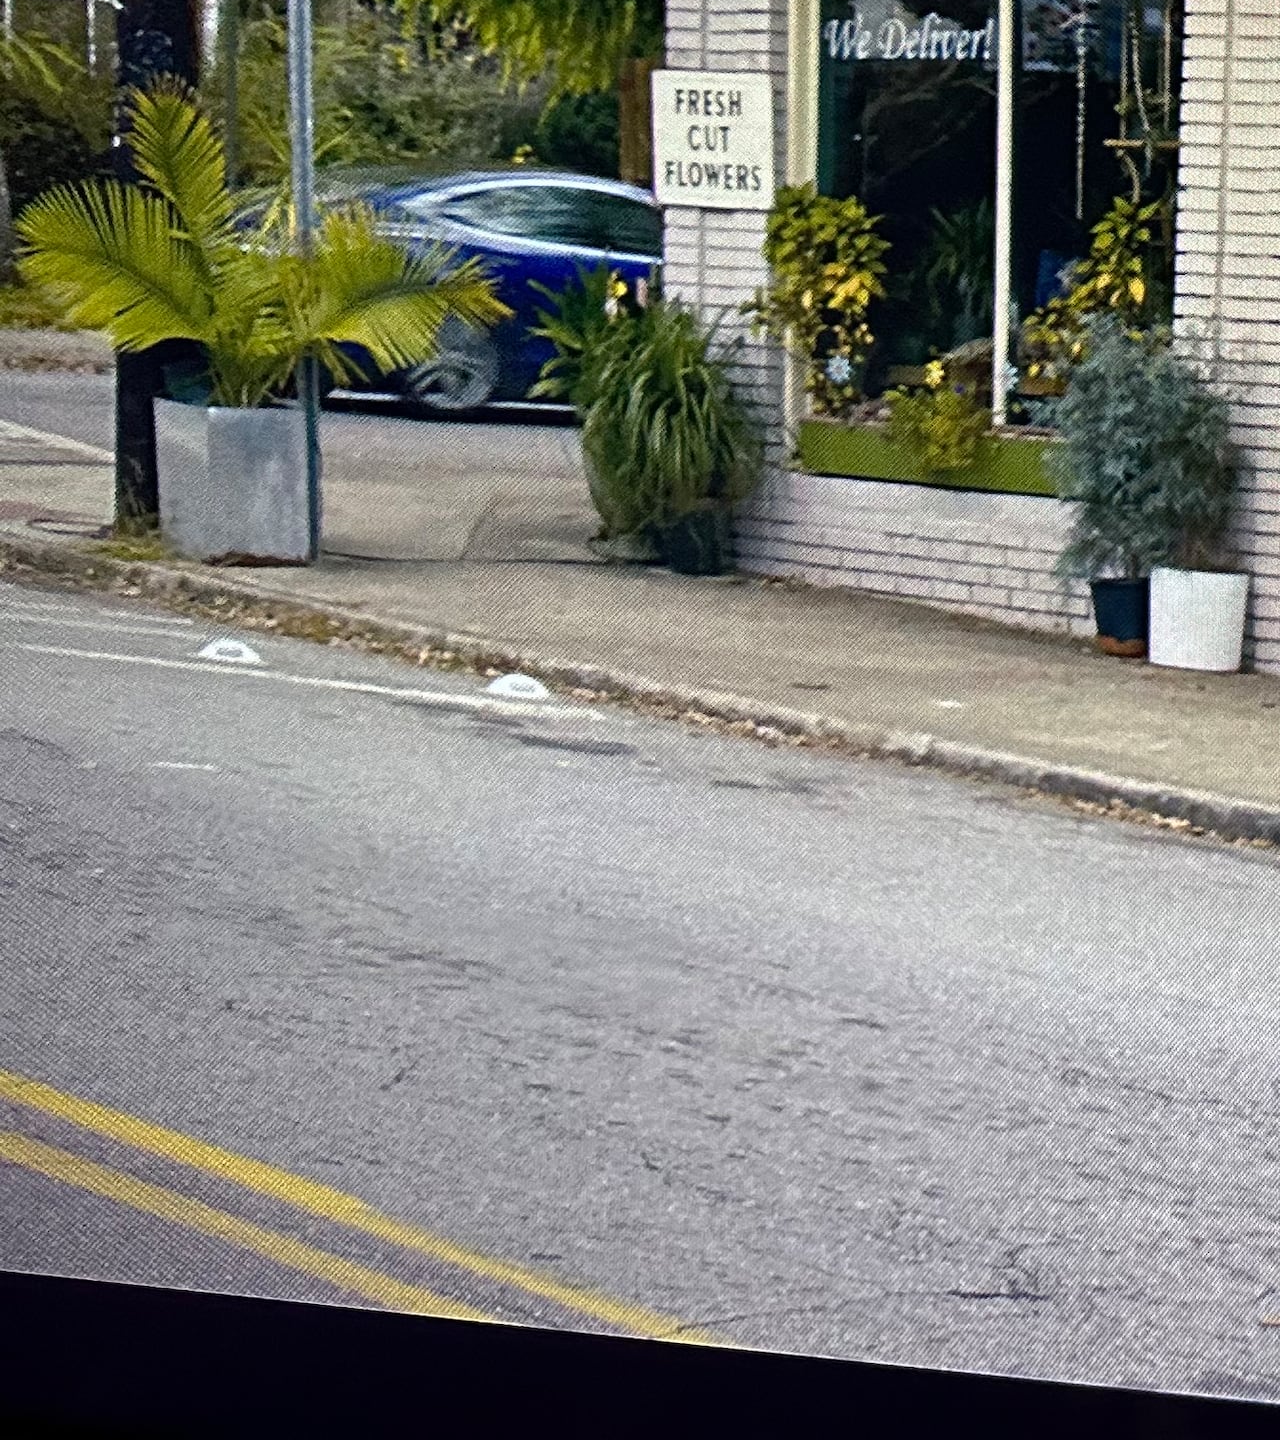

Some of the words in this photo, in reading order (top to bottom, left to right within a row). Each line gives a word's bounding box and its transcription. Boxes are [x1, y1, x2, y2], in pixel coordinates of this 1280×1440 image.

[823, 13, 872, 59] We
[877, 12, 994, 60] Deliver!
[674, 89, 742, 117] FRESH
[687, 124, 731, 153] CUT
[664, 160, 762, 192] FLOWERS
